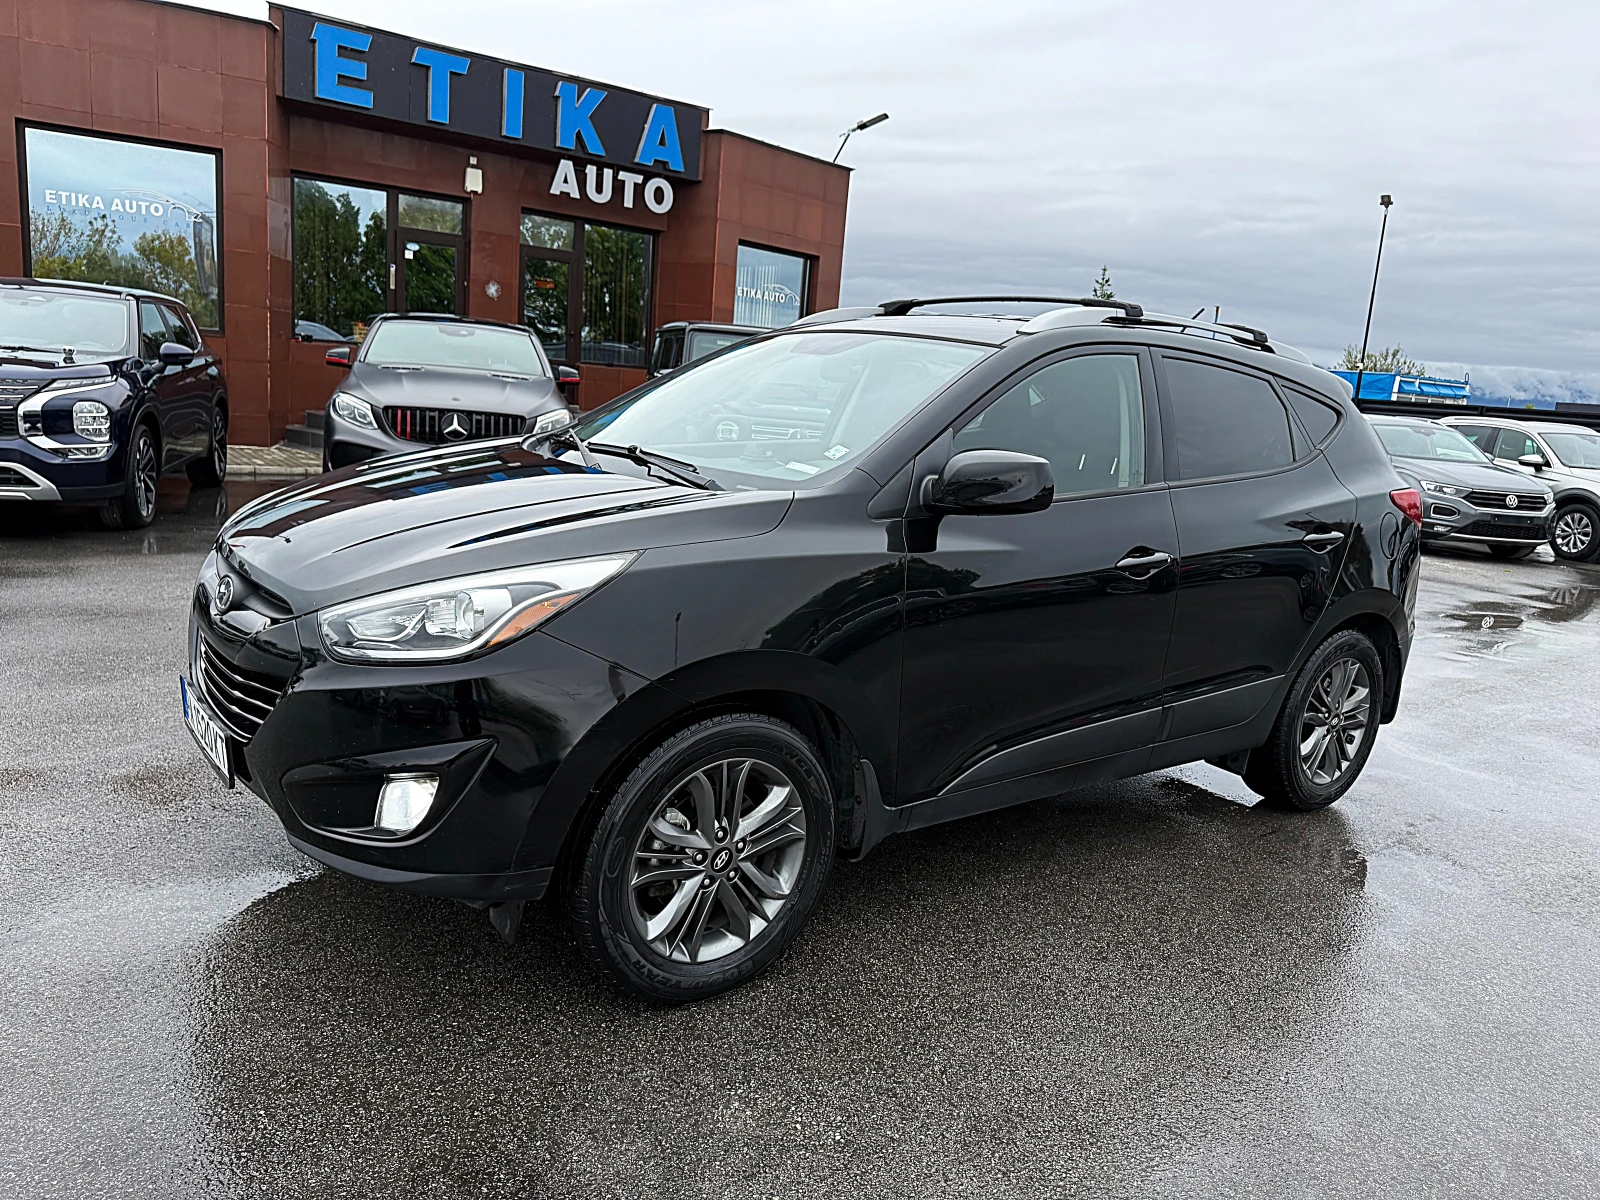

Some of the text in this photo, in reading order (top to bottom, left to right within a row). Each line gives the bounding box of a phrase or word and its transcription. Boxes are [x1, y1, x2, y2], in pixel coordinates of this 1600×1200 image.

[310, 22, 684, 172] ETIKA
[44, 190, 164, 217] ETIKA AUTO
[550, 159, 674, 214] AUTO
[737, 286, 786, 303] ETIKA AUTO
